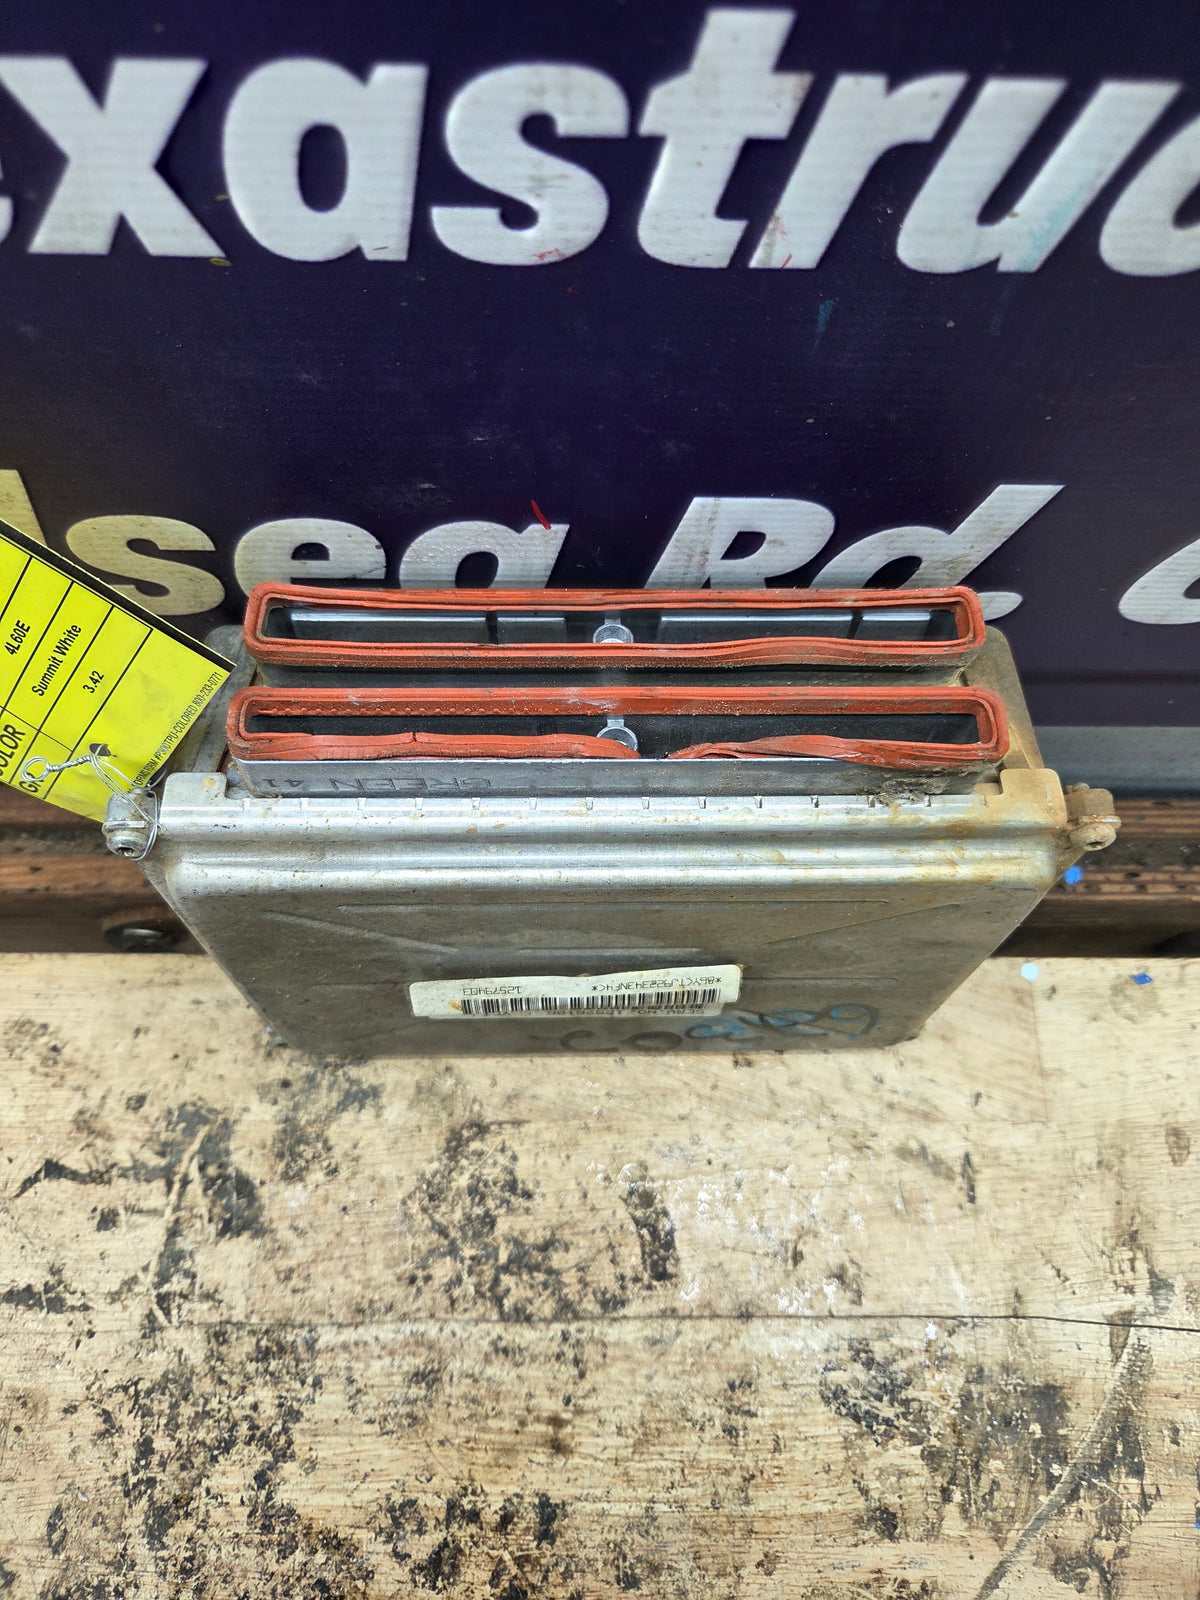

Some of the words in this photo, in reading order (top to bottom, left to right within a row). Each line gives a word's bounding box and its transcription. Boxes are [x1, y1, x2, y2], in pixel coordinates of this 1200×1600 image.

[0, 9, 1200, 277] xastru
[5, 619, 31, 656] 4L60E
[32, 657, 64, 696] Summit
[52, 624, 82, 664] White
[82, 670, 104, 694] 3.42
[0, 724, 26, 776] OLOR
[329, 777, 492, 790] GREEN
[463, 985, 521, 995] 12579403
